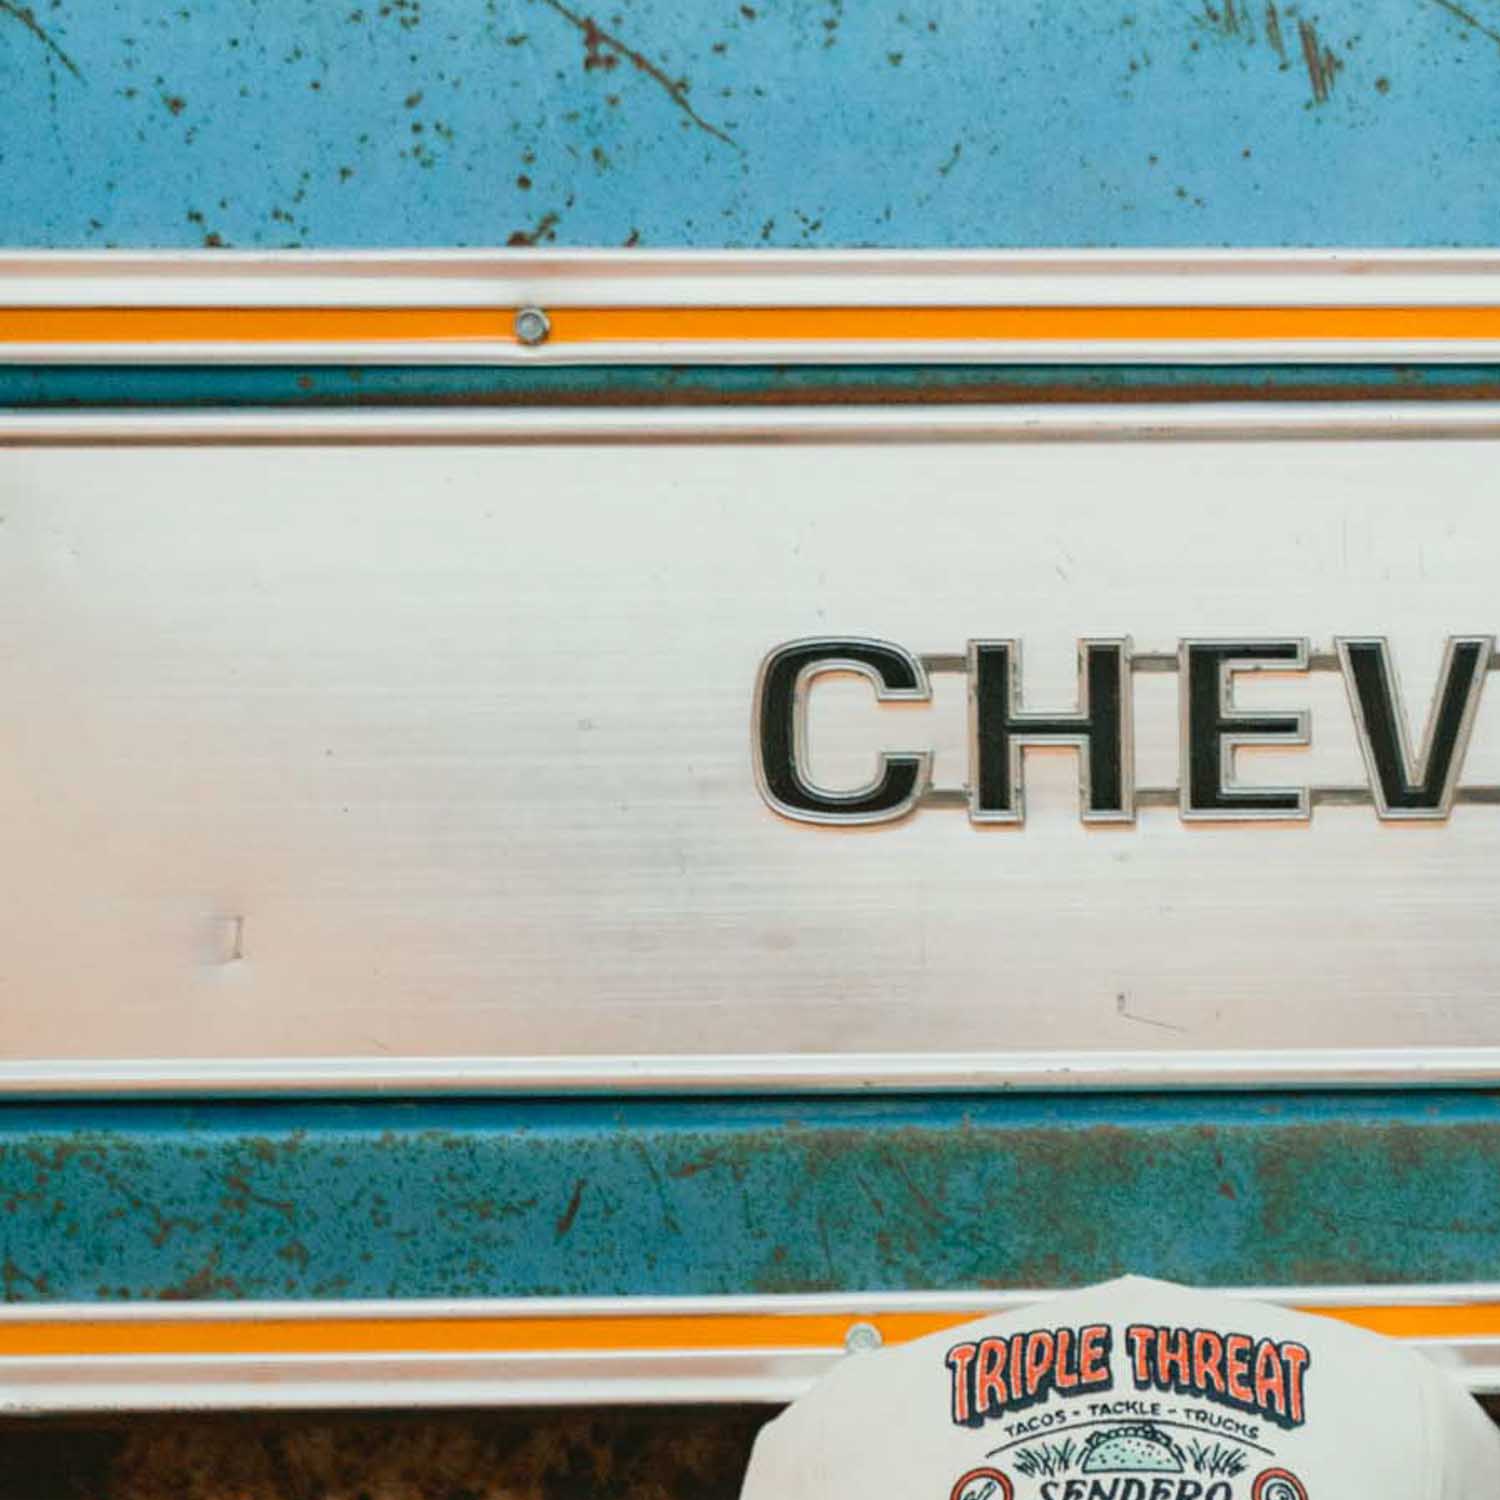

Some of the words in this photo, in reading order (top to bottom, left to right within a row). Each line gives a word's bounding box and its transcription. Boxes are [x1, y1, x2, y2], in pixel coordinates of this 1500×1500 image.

[945, 1323, 1112, 1429] TRIPLE
[1126, 1323, 1311, 1430] THREAT
[1003, 1409, 1068, 1439] TACOS
[1087, 1400, 1162, 1417] TACKLE
[1183, 1407, 1260, 1440] TRUCKS
